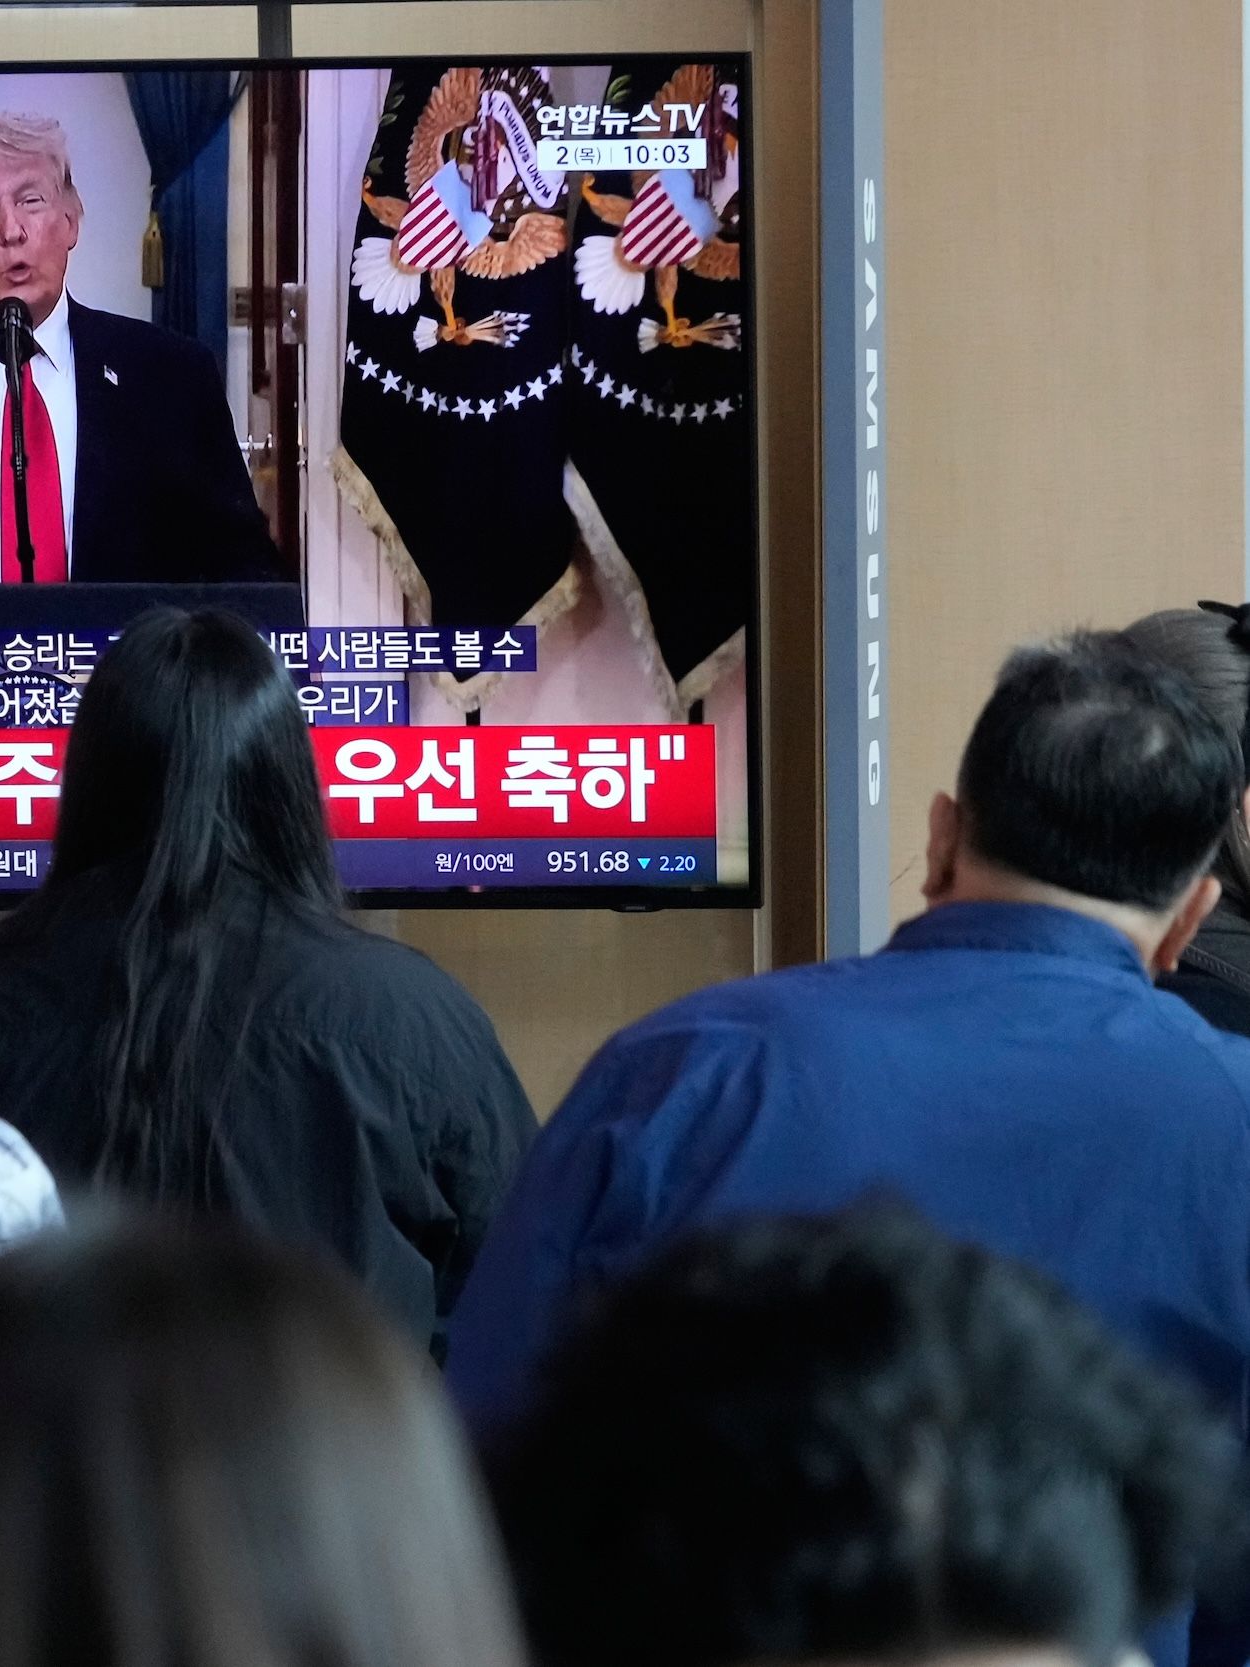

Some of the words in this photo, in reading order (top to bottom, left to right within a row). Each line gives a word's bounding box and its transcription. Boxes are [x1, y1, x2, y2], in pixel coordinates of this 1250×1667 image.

[536, 103, 706, 136] 연합뉴스TV
[624, 145, 690, 164] 10:03
[863, 178, 880, 806] SAMSUNG
[2, 634, 97, 671] 승리는
[318, 631, 444, 669] 사람들도
[451, 630, 484, 668] 볼
[491, 631, 525, 668] 수
[297, 685, 398, 724] 우리가
[328, 738, 478, 824] 우선
[500, 734, 686, 824] 축하"
[434, 851, 515, 874] 원/100엔
[547, 850, 630, 874] 951.68
[659, 855, 697, 872] 2.20
